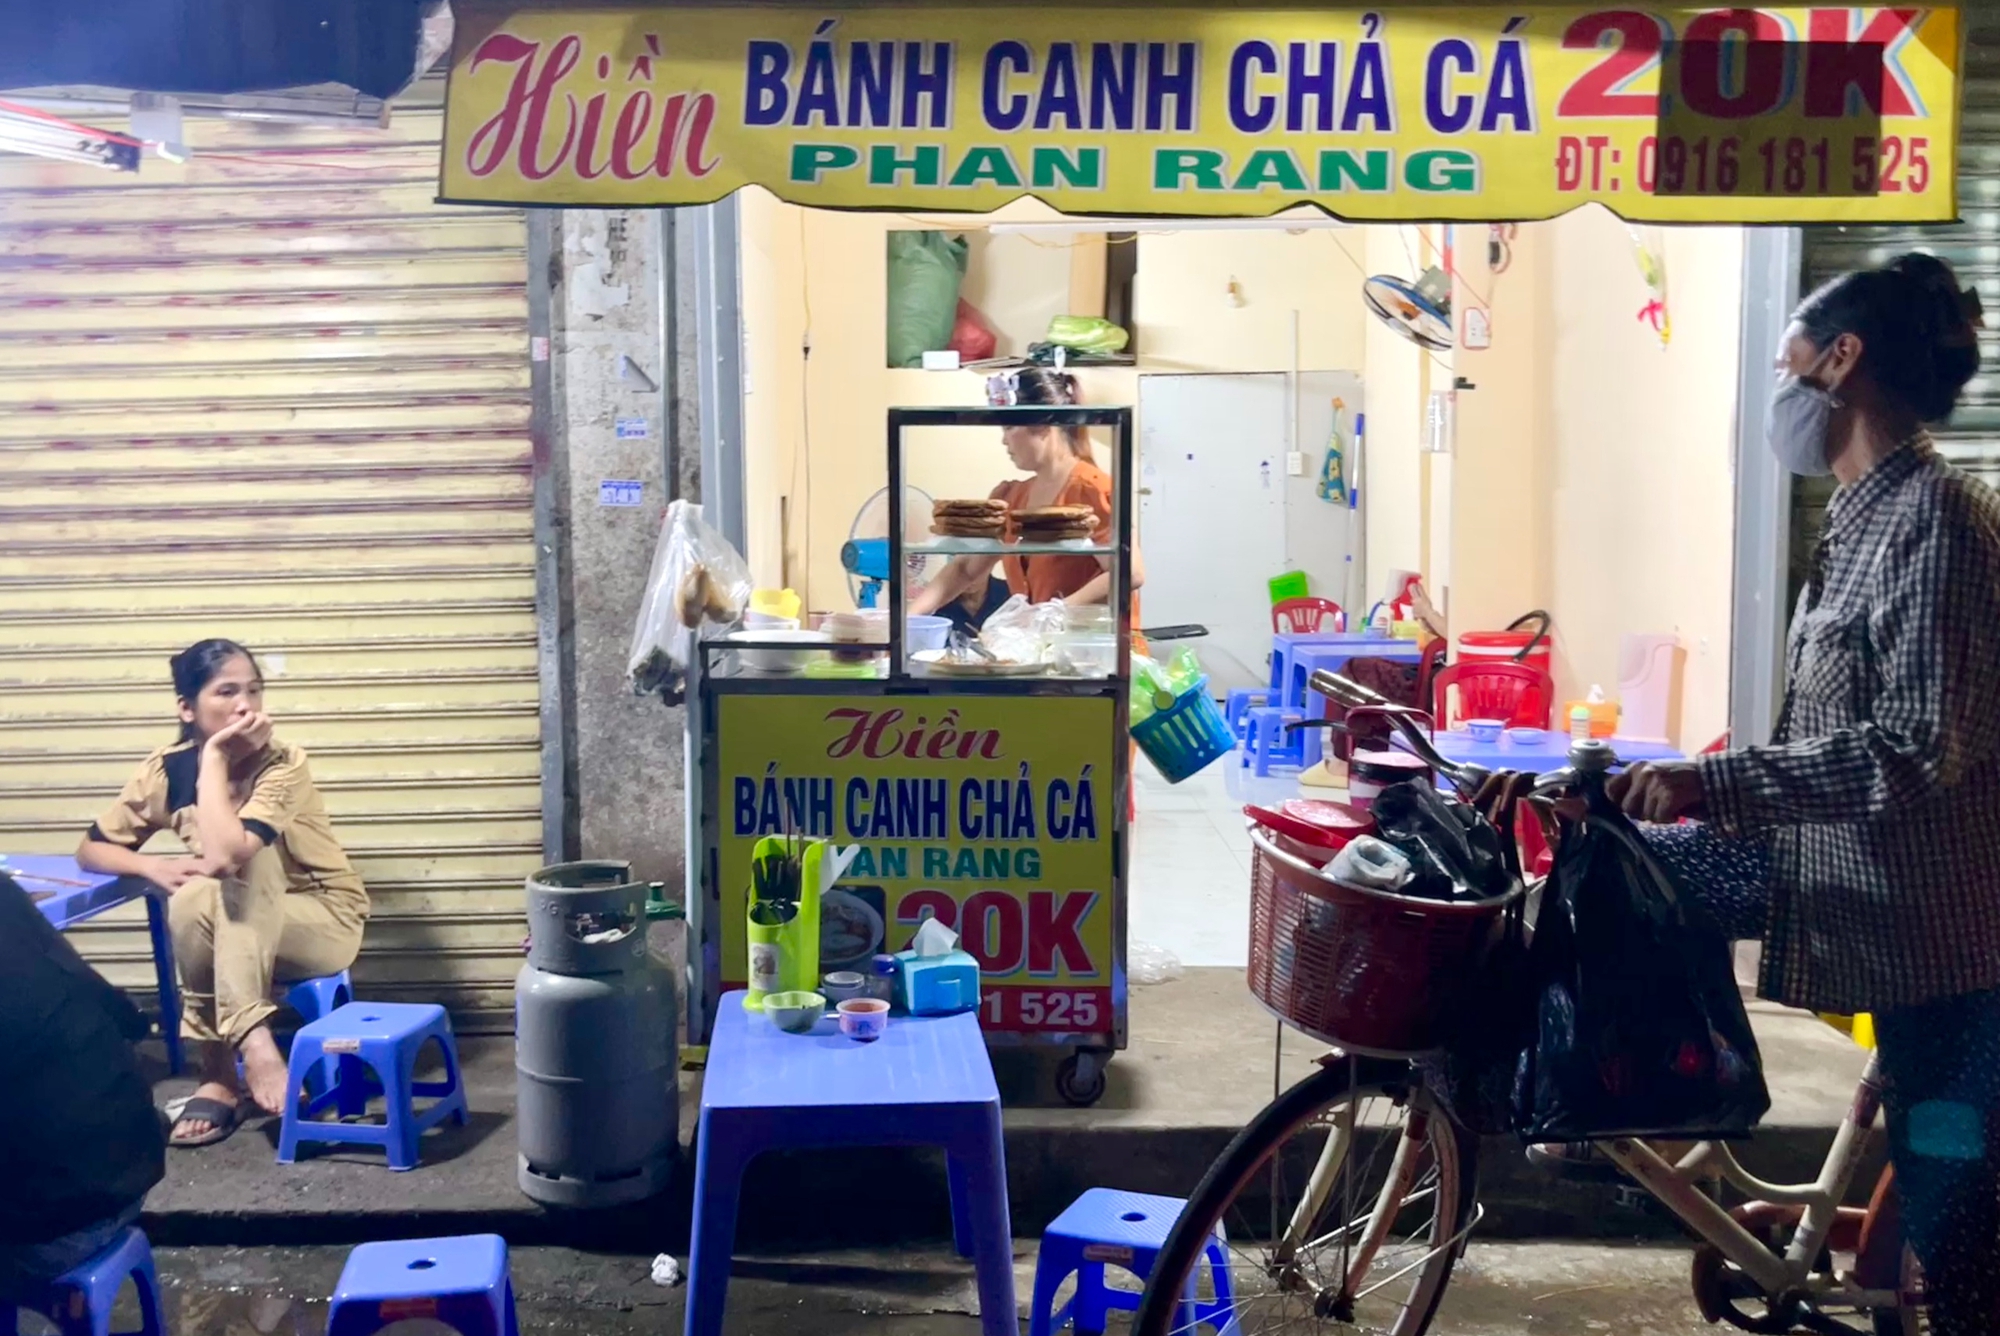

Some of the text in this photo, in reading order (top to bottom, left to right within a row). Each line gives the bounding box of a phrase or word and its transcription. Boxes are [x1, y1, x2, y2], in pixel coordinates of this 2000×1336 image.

[744, 14, 1532, 132] BÁNH CANH CHẢ CÁ
[1556, 8, 1925, 118] 20K
[468, 32, 721, 180] Hiền
[791, 145, 1477, 192] PHAN RANG
[1555, 136, 1929, 193] ĐT: 0916 181 525
[824, 707, 1007, 760] Hiền
[734, 761, 1097, 839] BÁNH CANH CHẢ CÁ
[924, 847, 1041, 878] RANG
[1020, 992, 1098, 1026] 525
